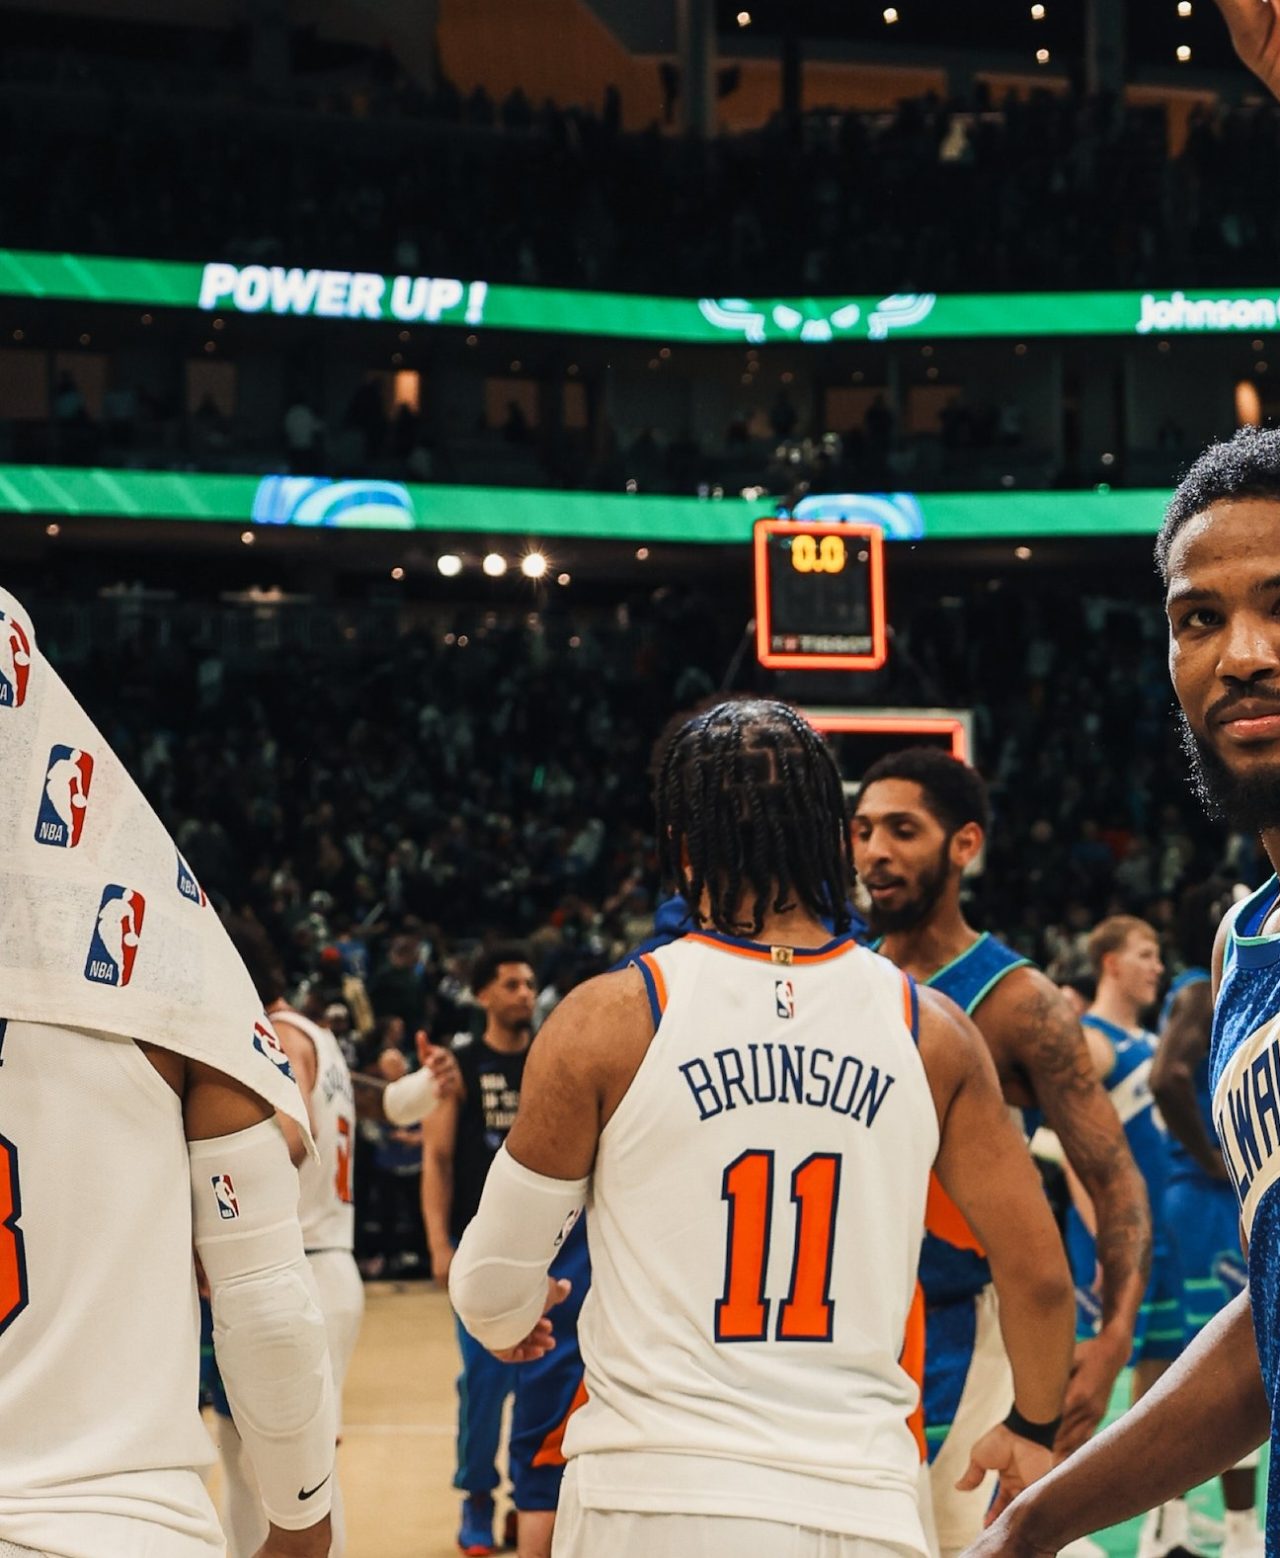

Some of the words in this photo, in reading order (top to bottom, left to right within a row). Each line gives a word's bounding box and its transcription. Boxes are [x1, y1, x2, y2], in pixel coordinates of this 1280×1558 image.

[198, 262, 386, 319] POWER
[1136, 290, 1276, 334] Johnson
[791, 534, 845, 573] 0.0
[39, 821, 63, 843] NBA
[180, 875, 197, 898] NBA
[89, 960, 114, 981] NBA
[678, 1043, 896, 1129] BRUNSON
[714, 1148, 843, 1344] 11
